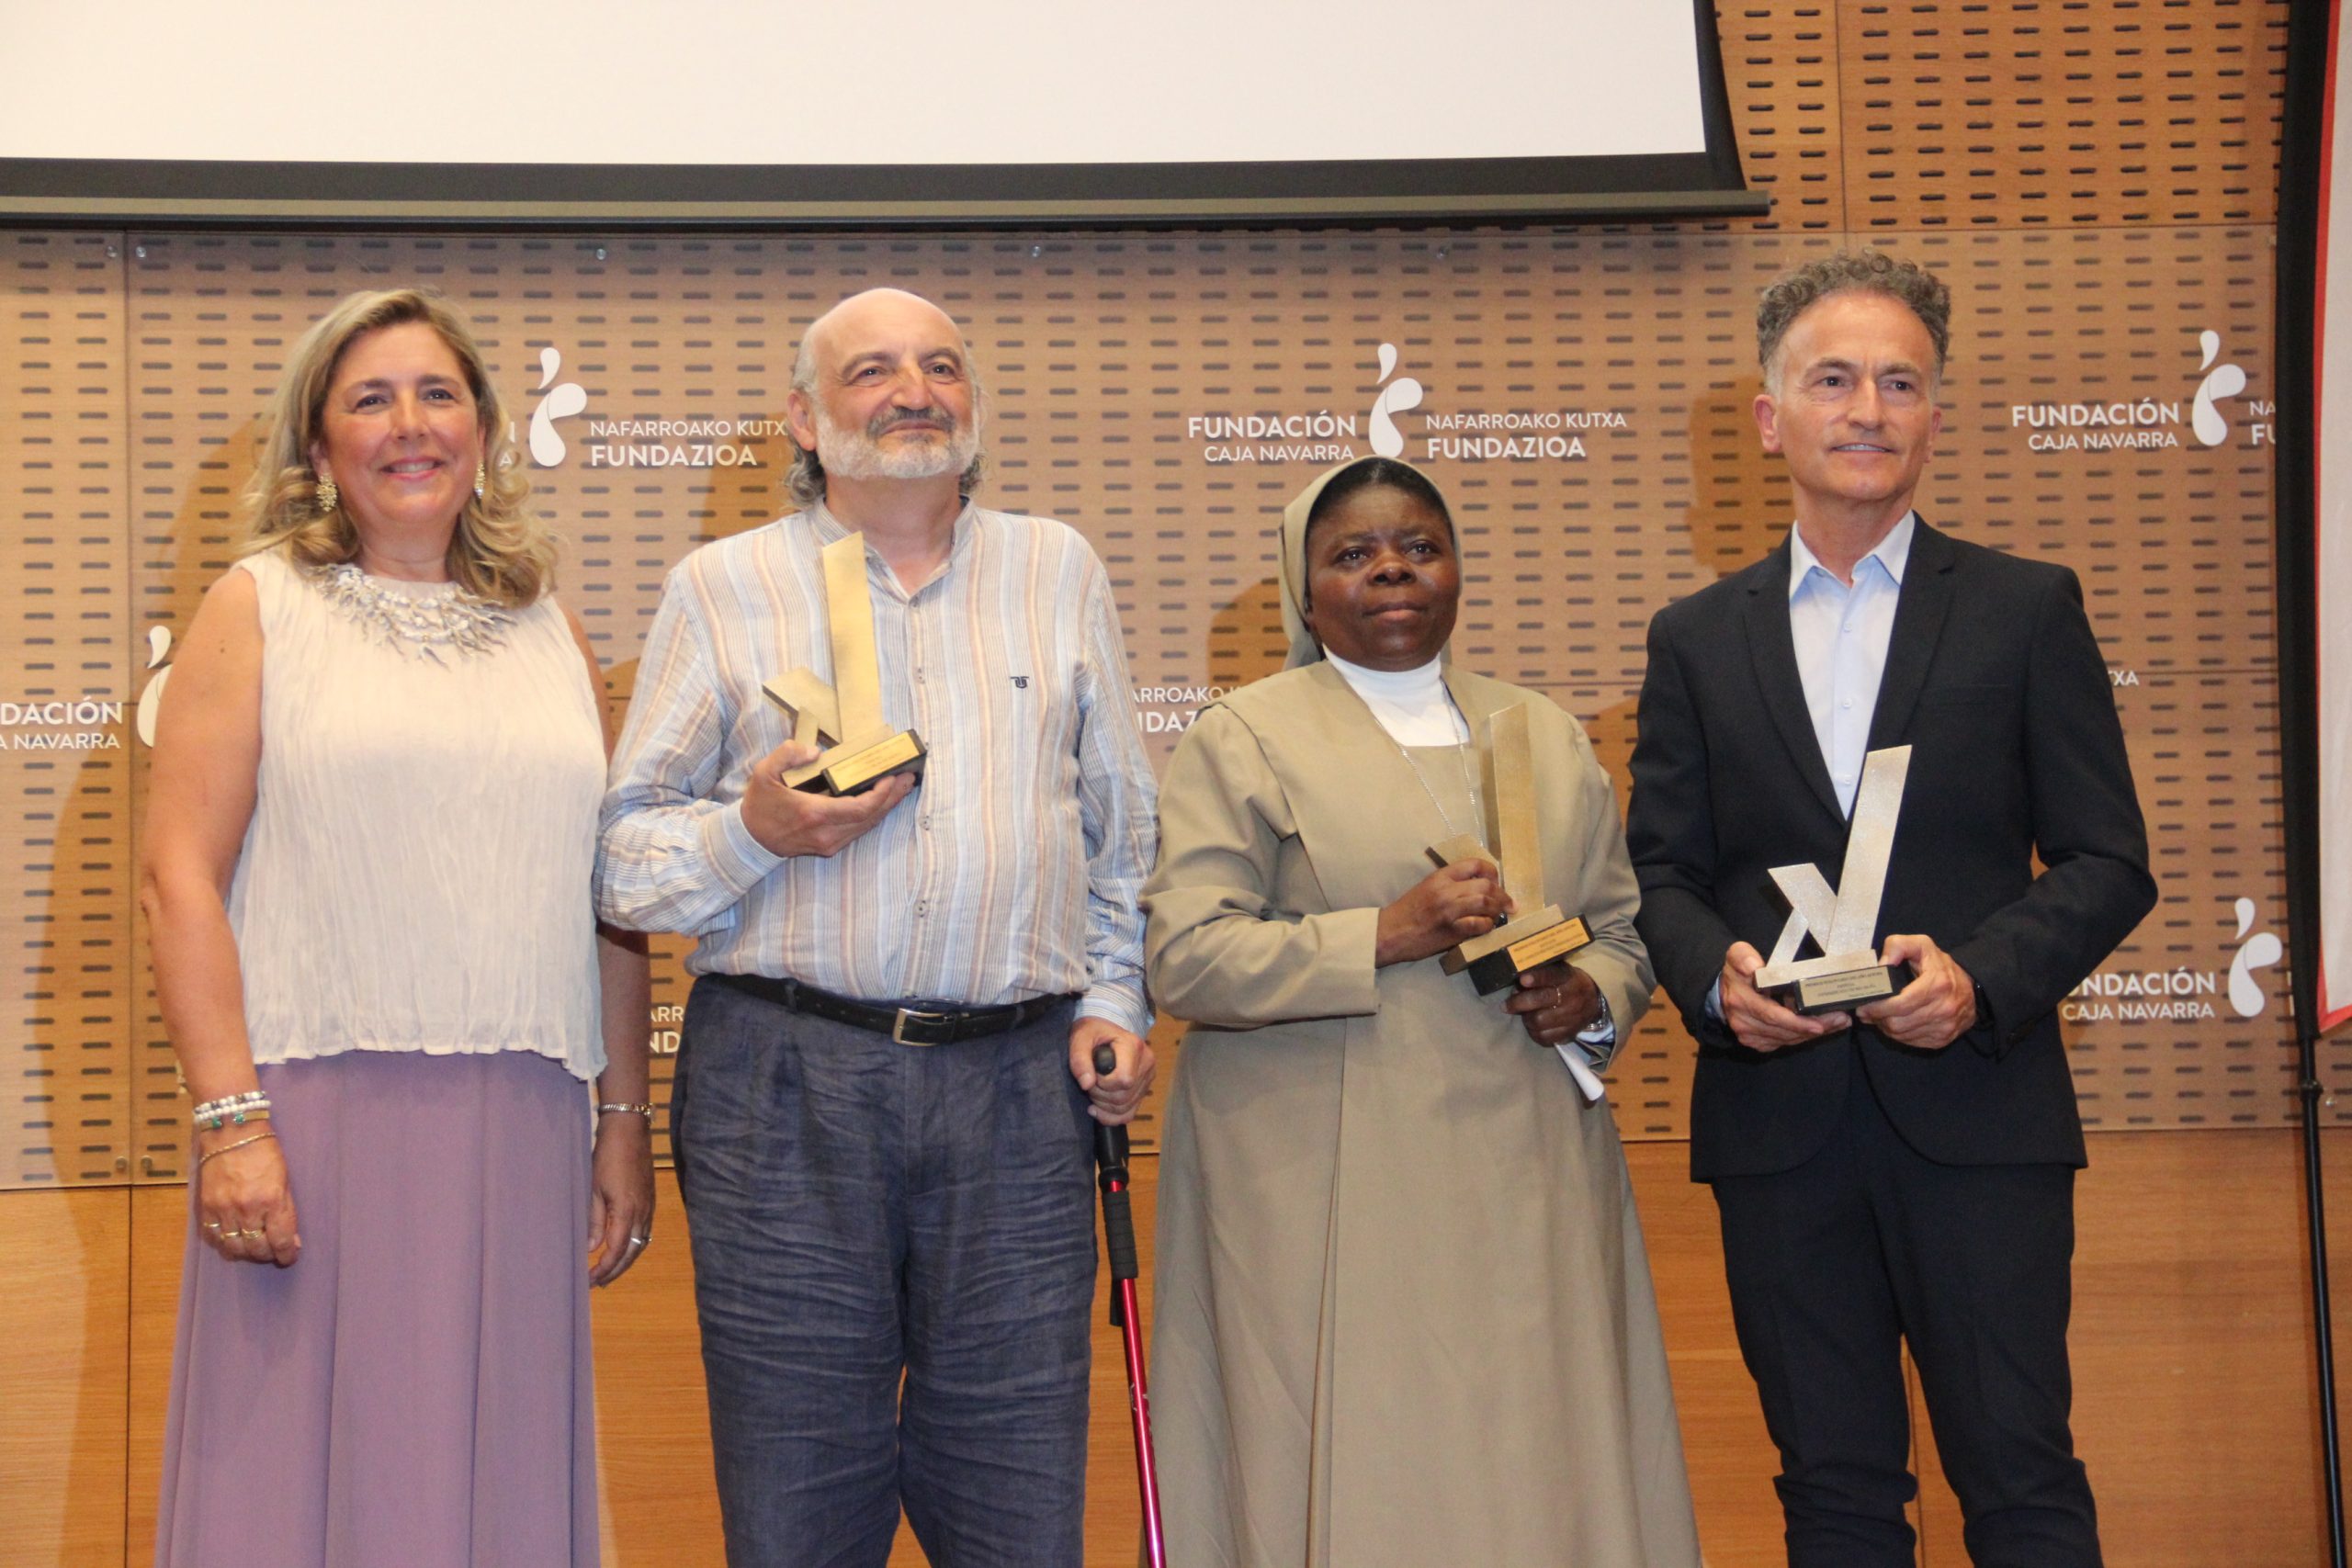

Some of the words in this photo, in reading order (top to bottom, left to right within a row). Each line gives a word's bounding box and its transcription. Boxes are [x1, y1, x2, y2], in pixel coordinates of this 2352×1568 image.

[1426, 412, 1561, 430] NAFARROAKO
[1566, 412, 1627, 428] KUTXA
[2012, 397, 2179, 427] FUNDACIÓN
[590, 420, 731, 436] NAFARROAKO
[737, 420, 787, 436] KUTX
[1188, 409, 1356, 439] FUNDACIÓN
[1428, 436, 1586, 459] FUNDAZIOA
[2028, 434, 2079, 450] CAJA
[2083, 431, 2178, 449] NAVARRA
[591, 445, 757, 467] FUNDAZIOA
[1204, 446, 1255, 462] CAJA
[1260, 444, 1354, 461] NAVARRA
[0, 695, 122, 726] DACIÓN
[14, 733, 120, 750] NAVARRA
[2067, 966, 2216, 996] NDACIÓN
[2062, 1003, 2114, 1021] CAJA
[2118, 1001, 2215, 1020] NAVARRA
